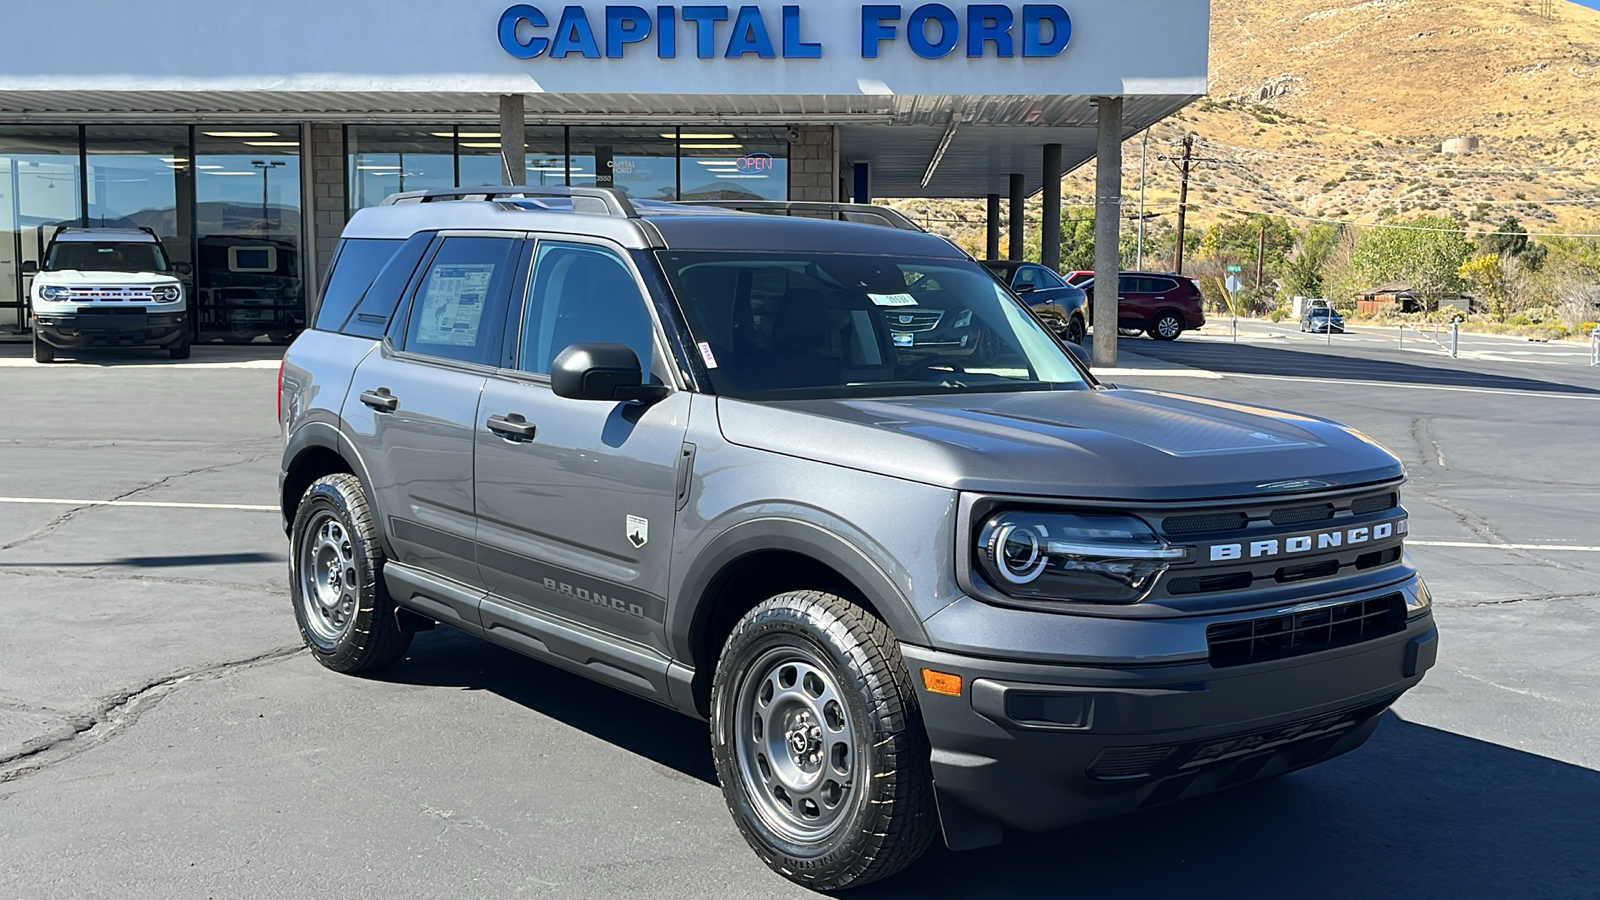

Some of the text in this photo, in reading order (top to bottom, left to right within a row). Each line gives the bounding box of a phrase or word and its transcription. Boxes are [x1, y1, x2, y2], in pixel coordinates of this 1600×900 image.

[497, 3, 1072, 59] CAPITAL FORD
[606, 160, 635, 168] CAPITAL
[736, 157, 772, 170] OPEN
[1210, 522, 1392, 562] BRONCO
[543, 577, 644, 619] BRONCO
